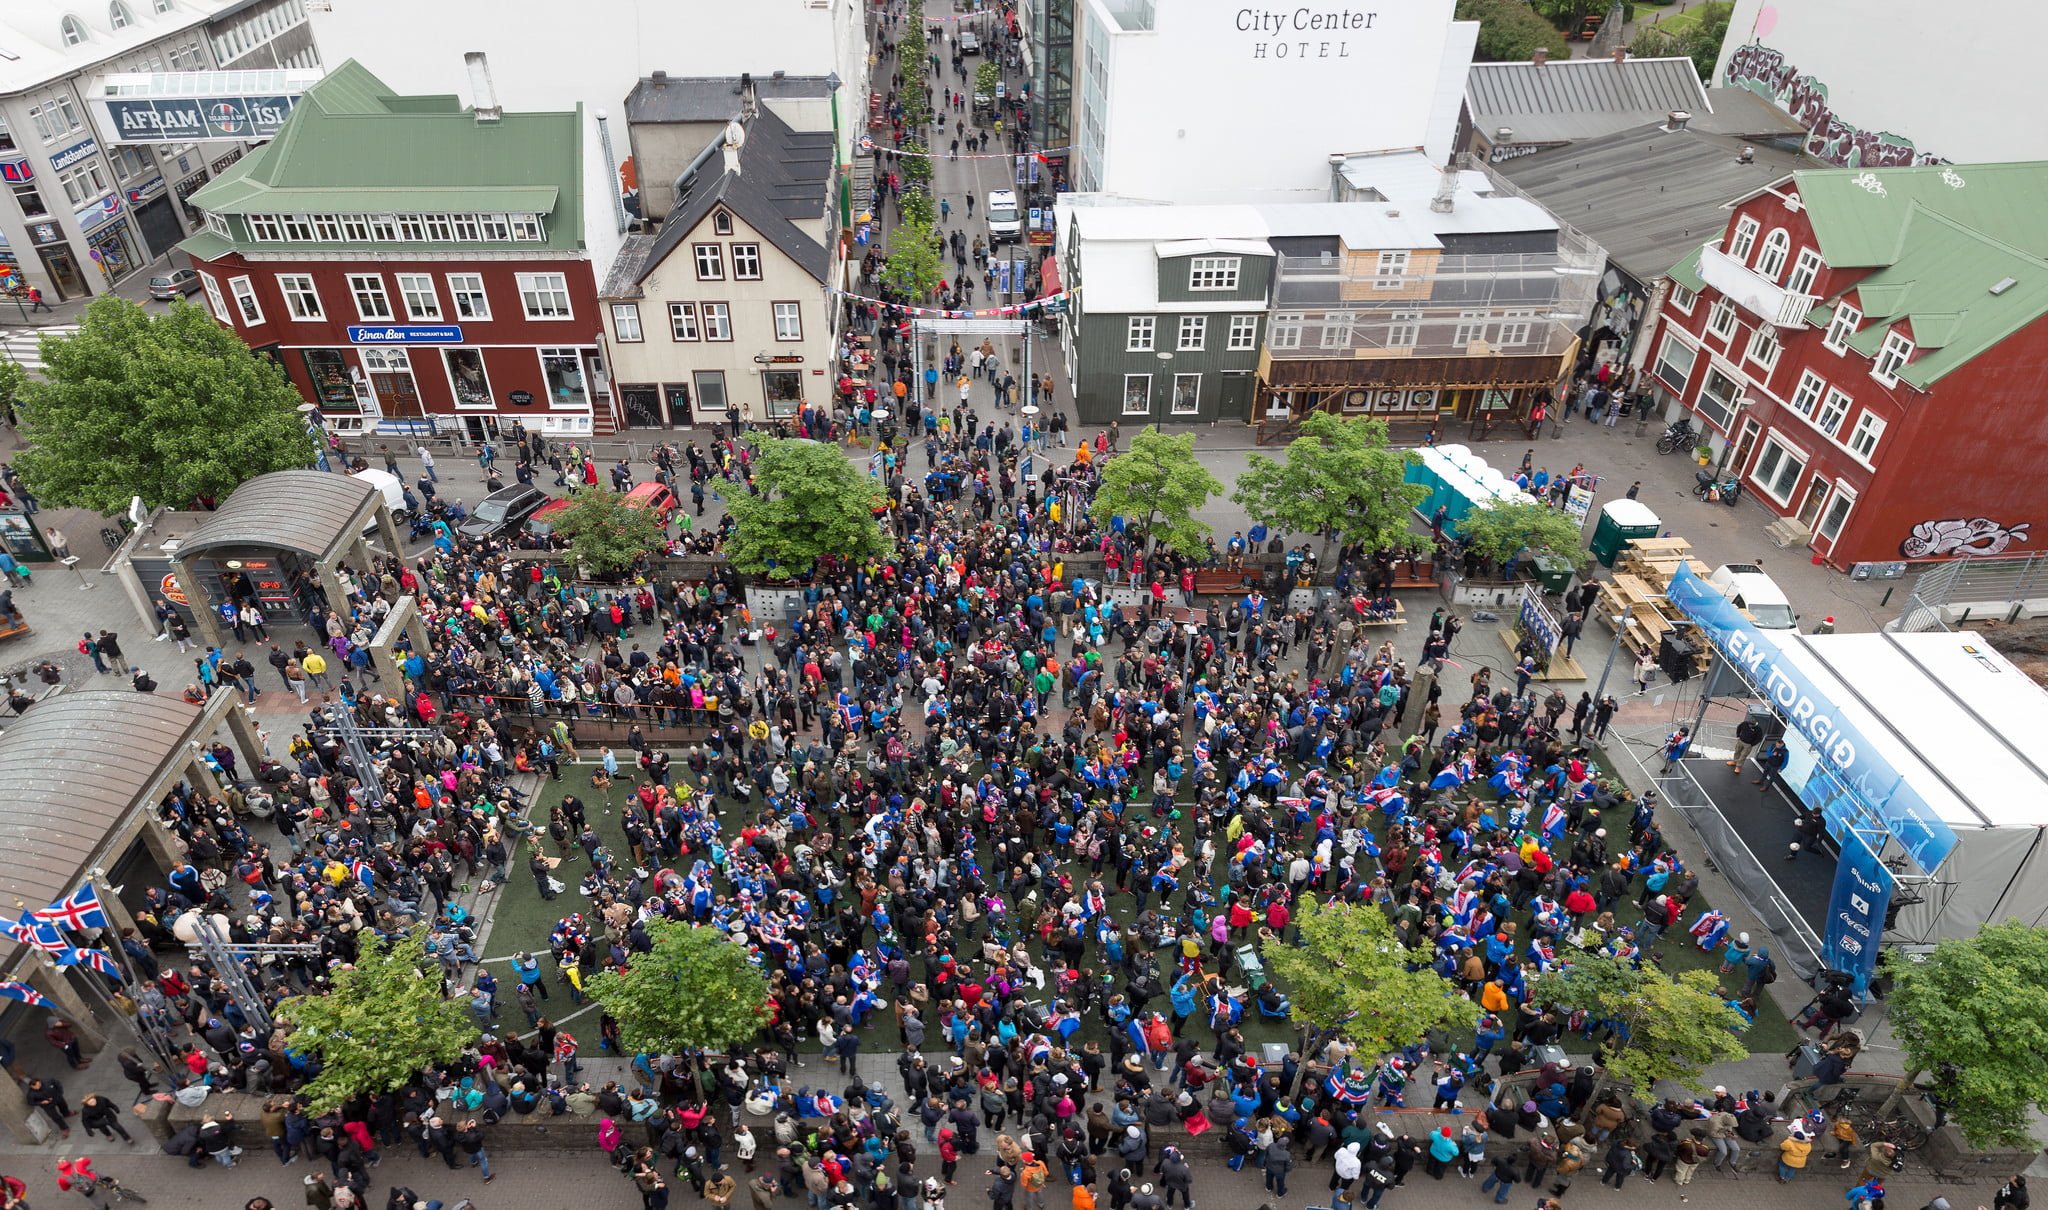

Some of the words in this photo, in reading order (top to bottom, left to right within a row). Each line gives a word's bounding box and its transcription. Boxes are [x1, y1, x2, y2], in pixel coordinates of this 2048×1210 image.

[1236, 9, 1287, 36] City
[1294, 8, 1377, 31] Center
[1254, 42, 1349, 58] HOTEL
[122, 106, 200, 130] ÁFRAM
[51, 143, 98, 170] Landsbankinn
[358, 329, 384, 341] Einar
[385, 329, 406, 340] Ben
[1727, 629, 1766, 673] EM
[1766, 663, 1857, 769] TORGIÐ
[1510, 814, 1519, 825] 22
[1369, 1169, 1387, 1184] APEX
